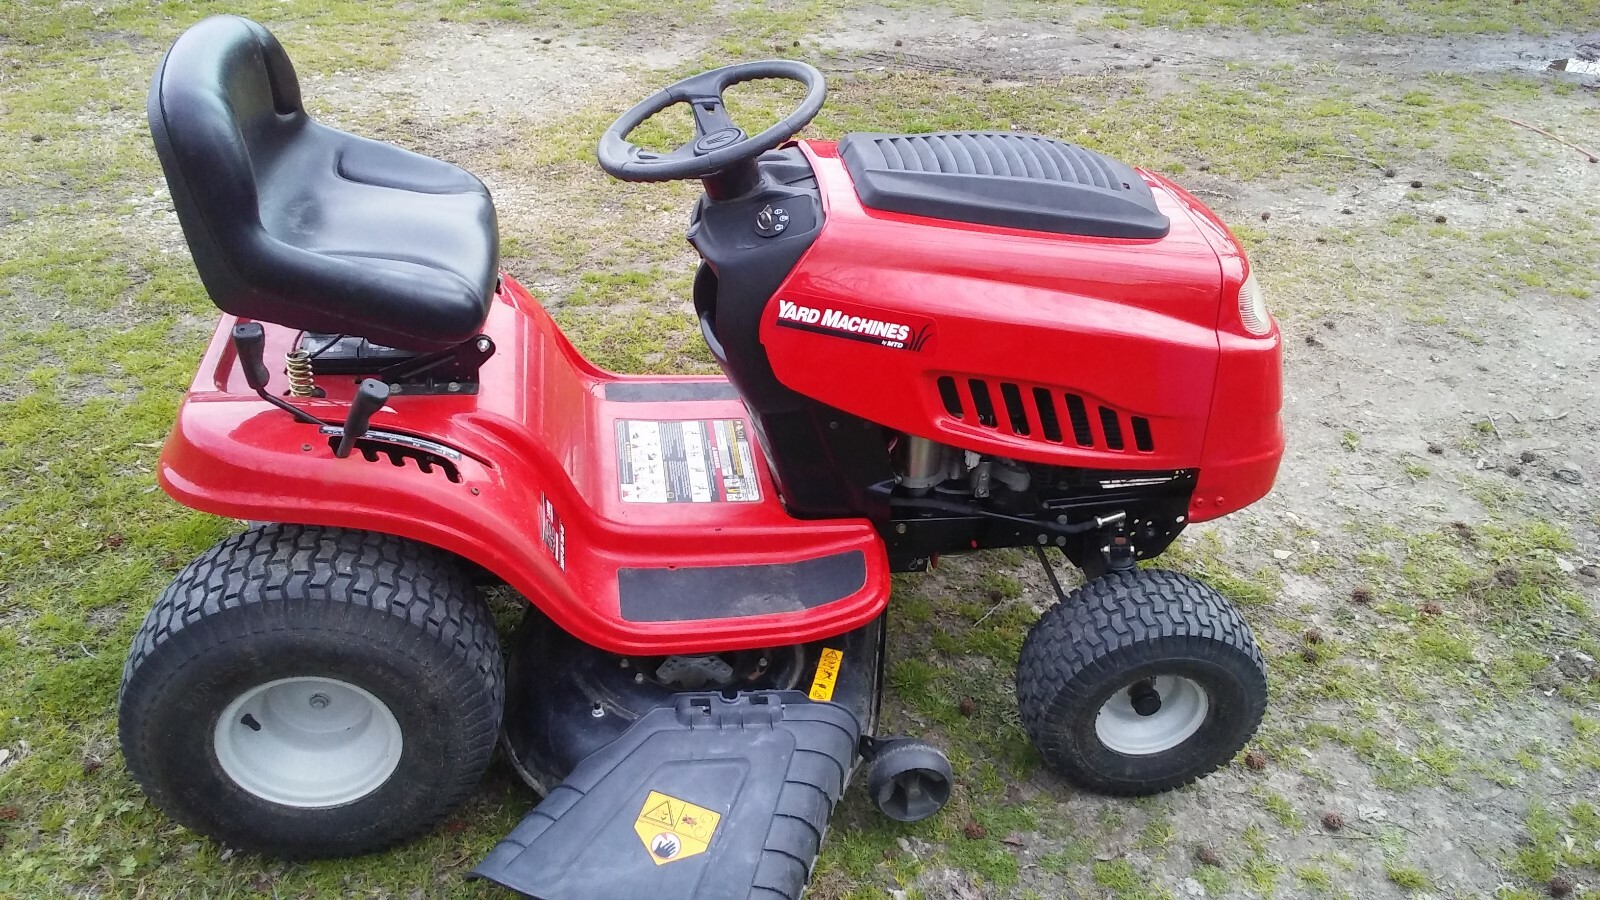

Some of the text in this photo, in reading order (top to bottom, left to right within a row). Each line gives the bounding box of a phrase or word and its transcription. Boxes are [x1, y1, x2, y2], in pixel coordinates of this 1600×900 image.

[778, 300, 910, 341] YARD MACHINES
[887, 340, 904, 349] MTD
